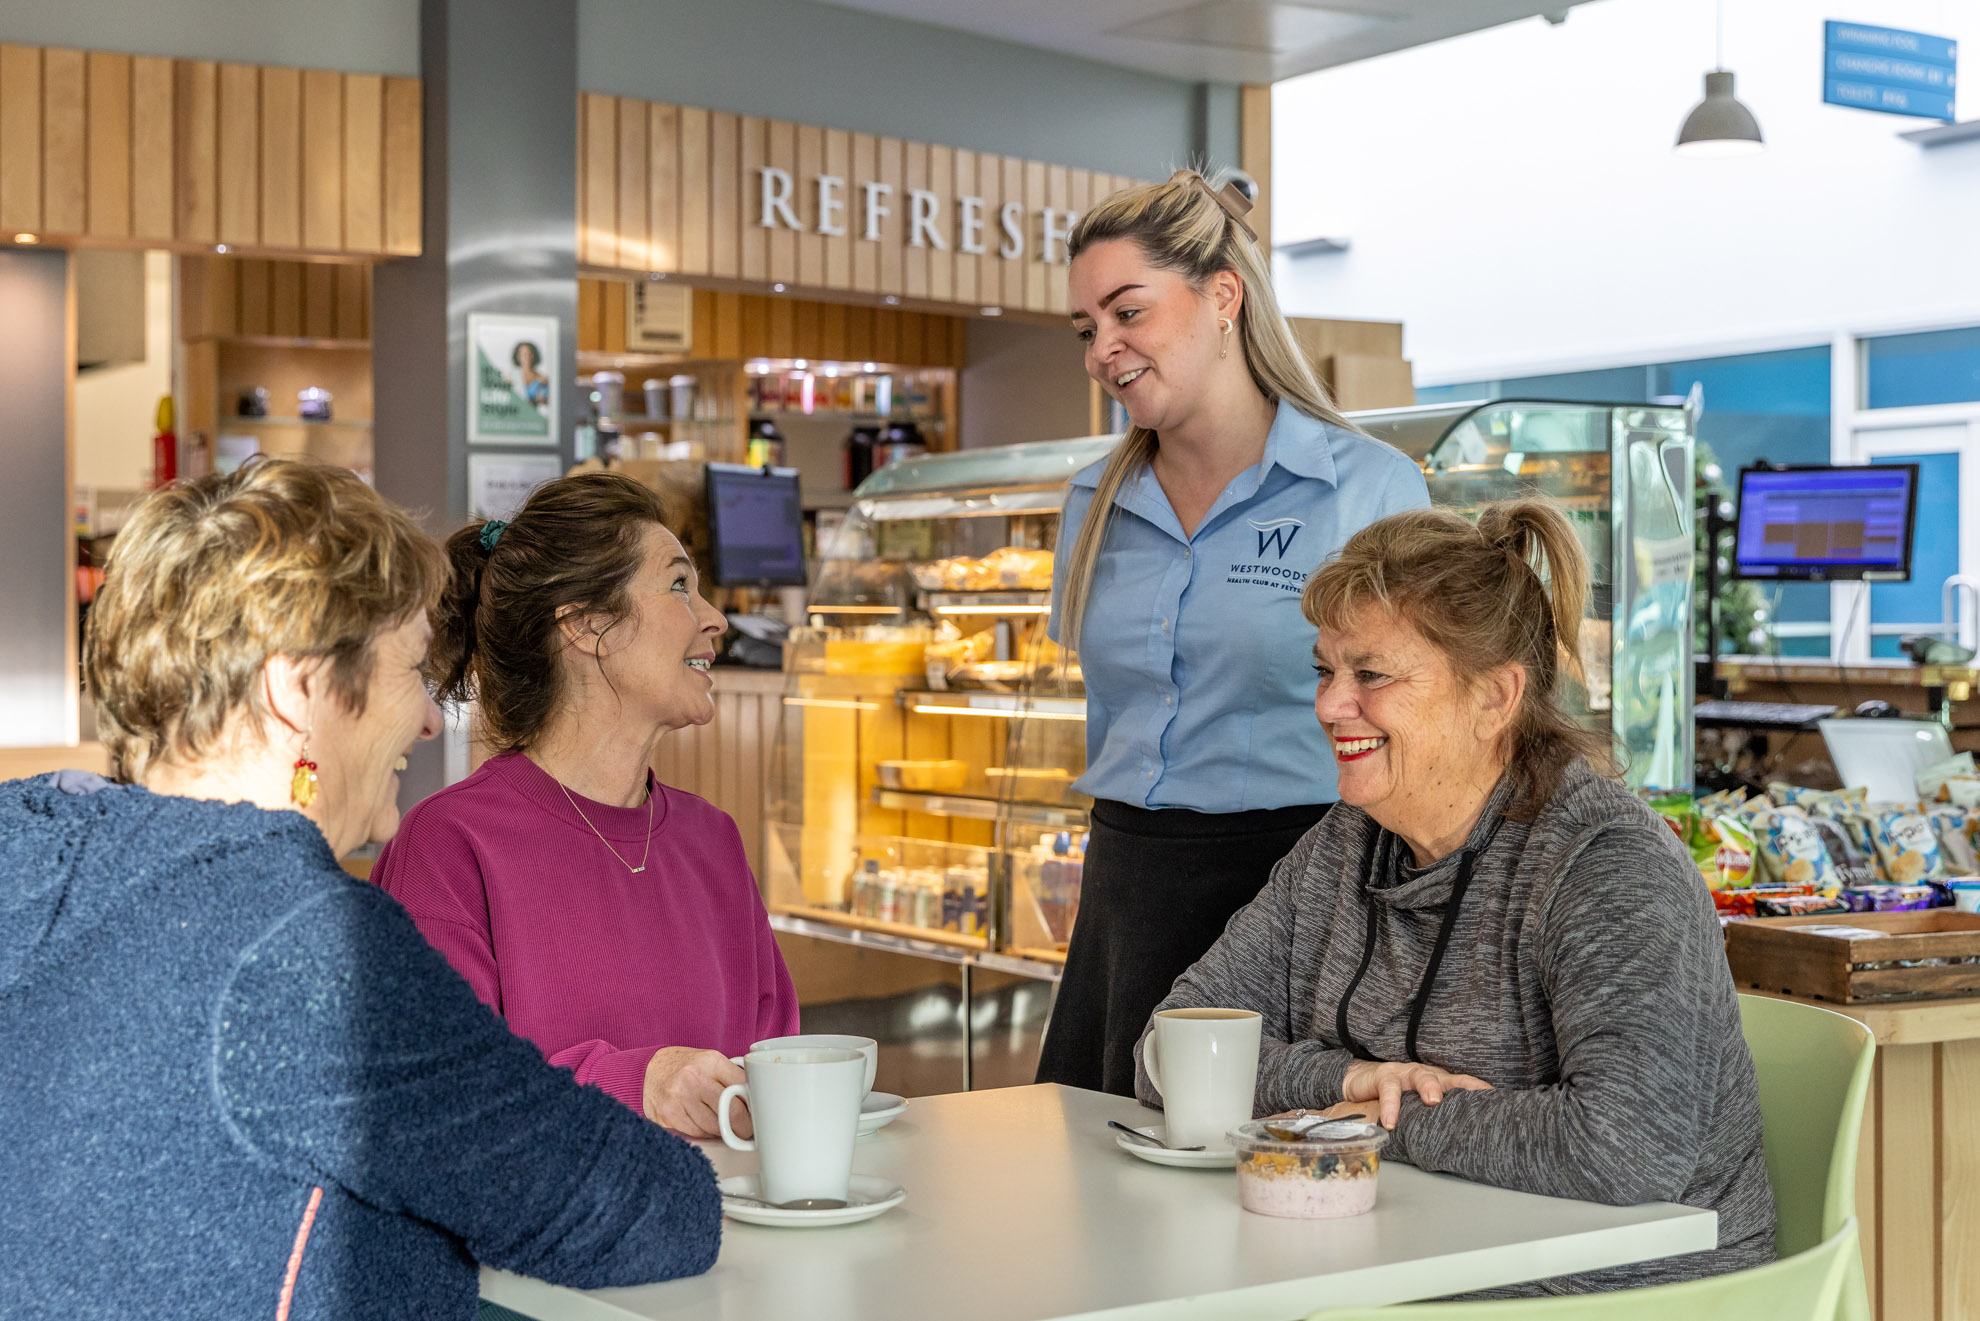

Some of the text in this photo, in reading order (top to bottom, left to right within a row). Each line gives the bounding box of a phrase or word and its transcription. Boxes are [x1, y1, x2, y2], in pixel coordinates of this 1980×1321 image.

[760, 166, 1078, 263] REFRESH
[1230, 564, 1307, 582] WESTWOODS
[1281, 584, 1303, 594] FETTE
